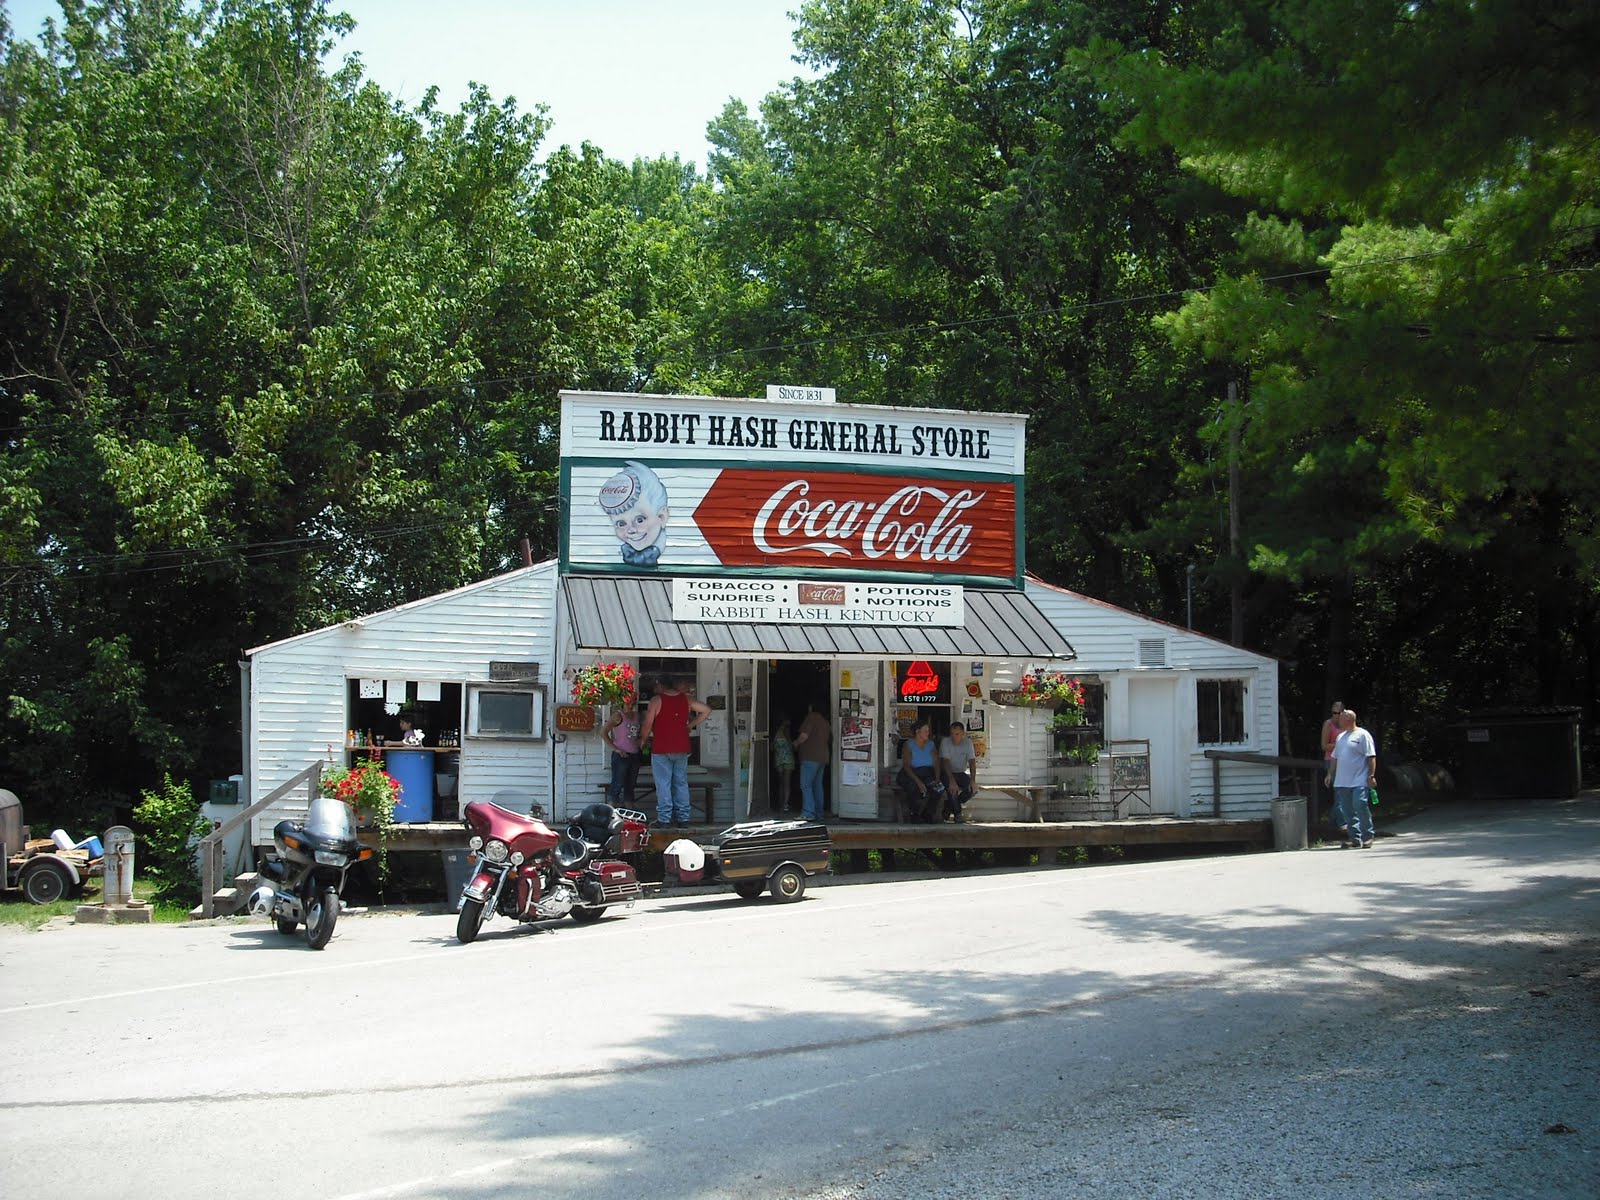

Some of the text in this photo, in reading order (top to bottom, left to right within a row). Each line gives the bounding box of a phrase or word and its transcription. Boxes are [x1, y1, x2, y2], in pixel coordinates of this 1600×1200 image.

[779, 387, 822, 401] SINCE 1831
[599, 410, 990, 459] RABBIT HASH GENERAL STORE
[752, 479, 988, 562] Coca-Cola
[686, 581, 775, 591] TOBACCO
[867, 587, 952, 597] POTIONS
[687, 593, 776, 603] SUNDRIES
[867, 597, 952, 607] NOTIONS
[700, 606, 769, 619] RABBIT
[840, 609, 935, 623] KENTUCKY
